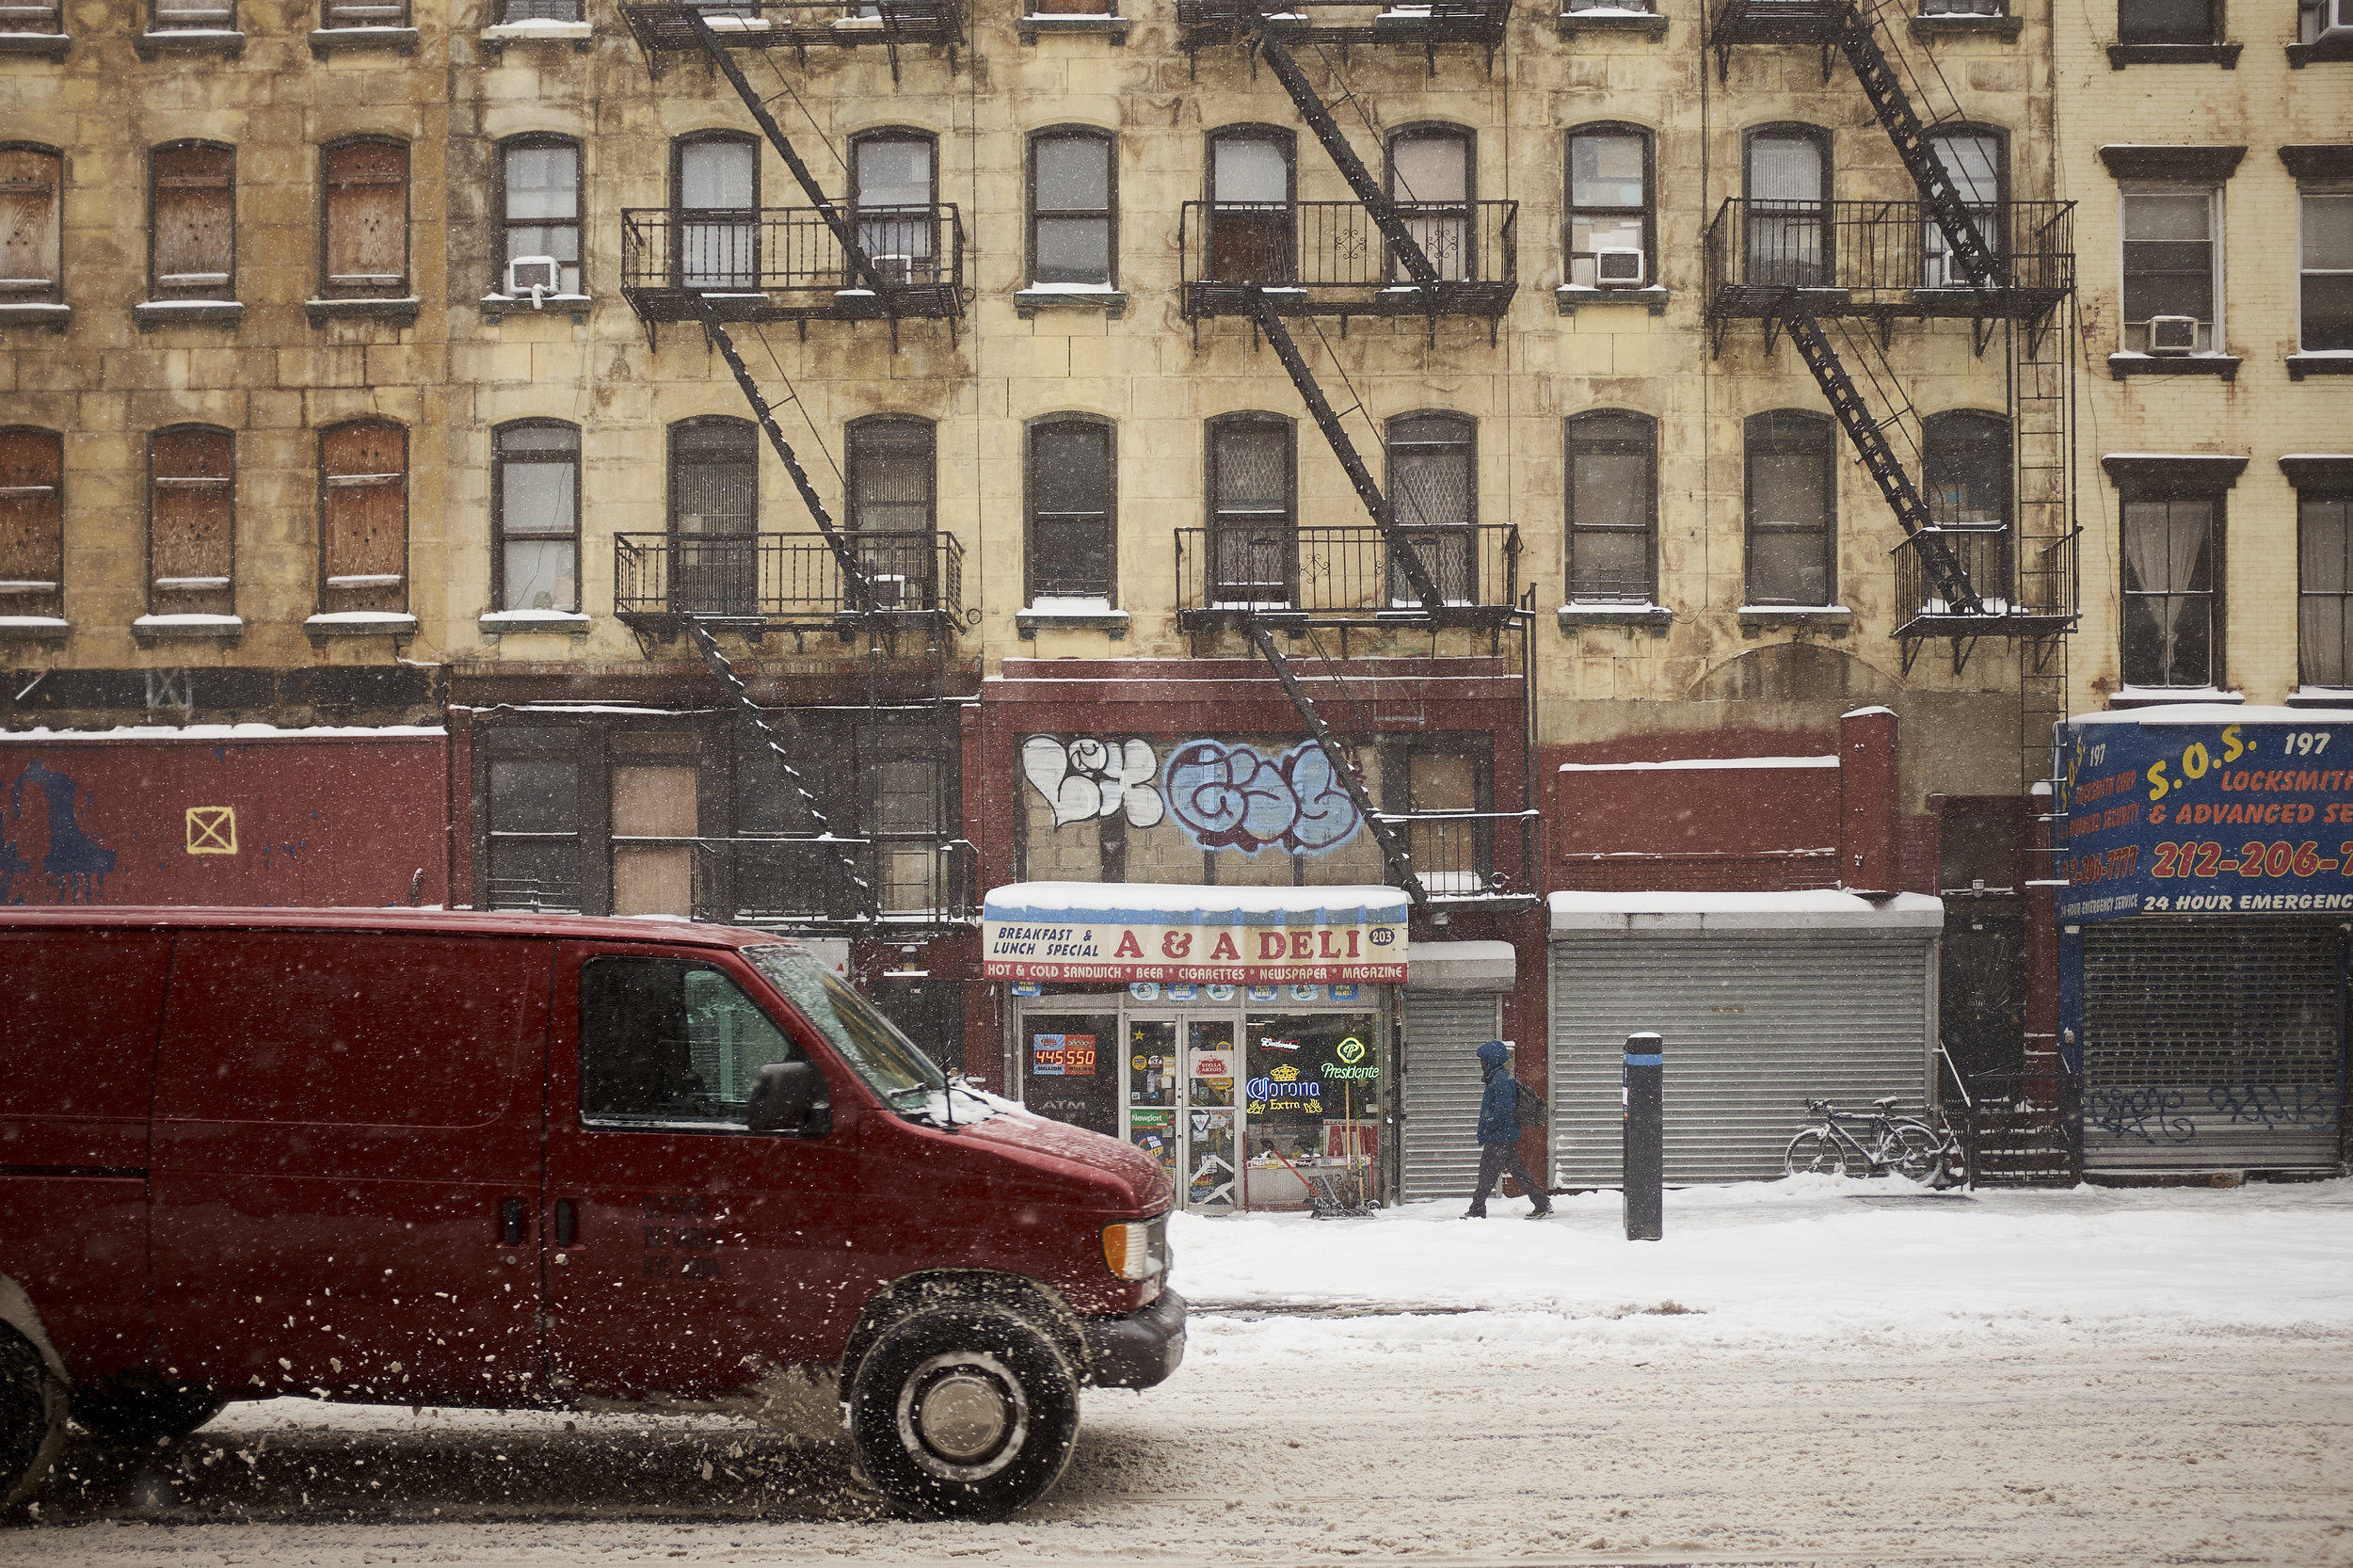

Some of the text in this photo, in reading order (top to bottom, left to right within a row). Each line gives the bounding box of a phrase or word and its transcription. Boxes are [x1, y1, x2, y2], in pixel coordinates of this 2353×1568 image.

[2284, 732, 2331, 756] 197
[2089, 743, 2106, 767] 197
[2147, 724, 2257, 801] S.O.S.
[2103, 802, 2140, 830] SECURITY
[2148, 803, 2167, 824] &
[2175, 803, 2315, 824] ADVANCED
[2082, 897, 2114, 915] EMERGENCY
[2115, 893, 2138, 910] SERVICE
[2143, 896, 2169, 911] 24
[2175, 895, 2233, 911] HOUR
[998, 926, 1093, 942] BREAKFAST &
[1372, 931, 1392, 943] 203
[993, 942, 1099, 957] LUNCH SPECIAL
[1113, 929, 1361, 960] A & A DELI
[987, 964, 1402, 980] HOT & COLD SANDWICH BEER CIGARETTES NEWSPAPER MAGAZINE
[1036, 1050, 1064, 1064] 445
[1066, 1050, 1095, 1064] 550
[1321, 1063, 1380, 1080] Presidente
[1245, 1077, 1321, 1101] Corona
[1040, 1099, 1086, 1110] ATM
[1269, 1098, 1301, 1111] Extra
[1131, 1114, 1162, 1123] Newport
